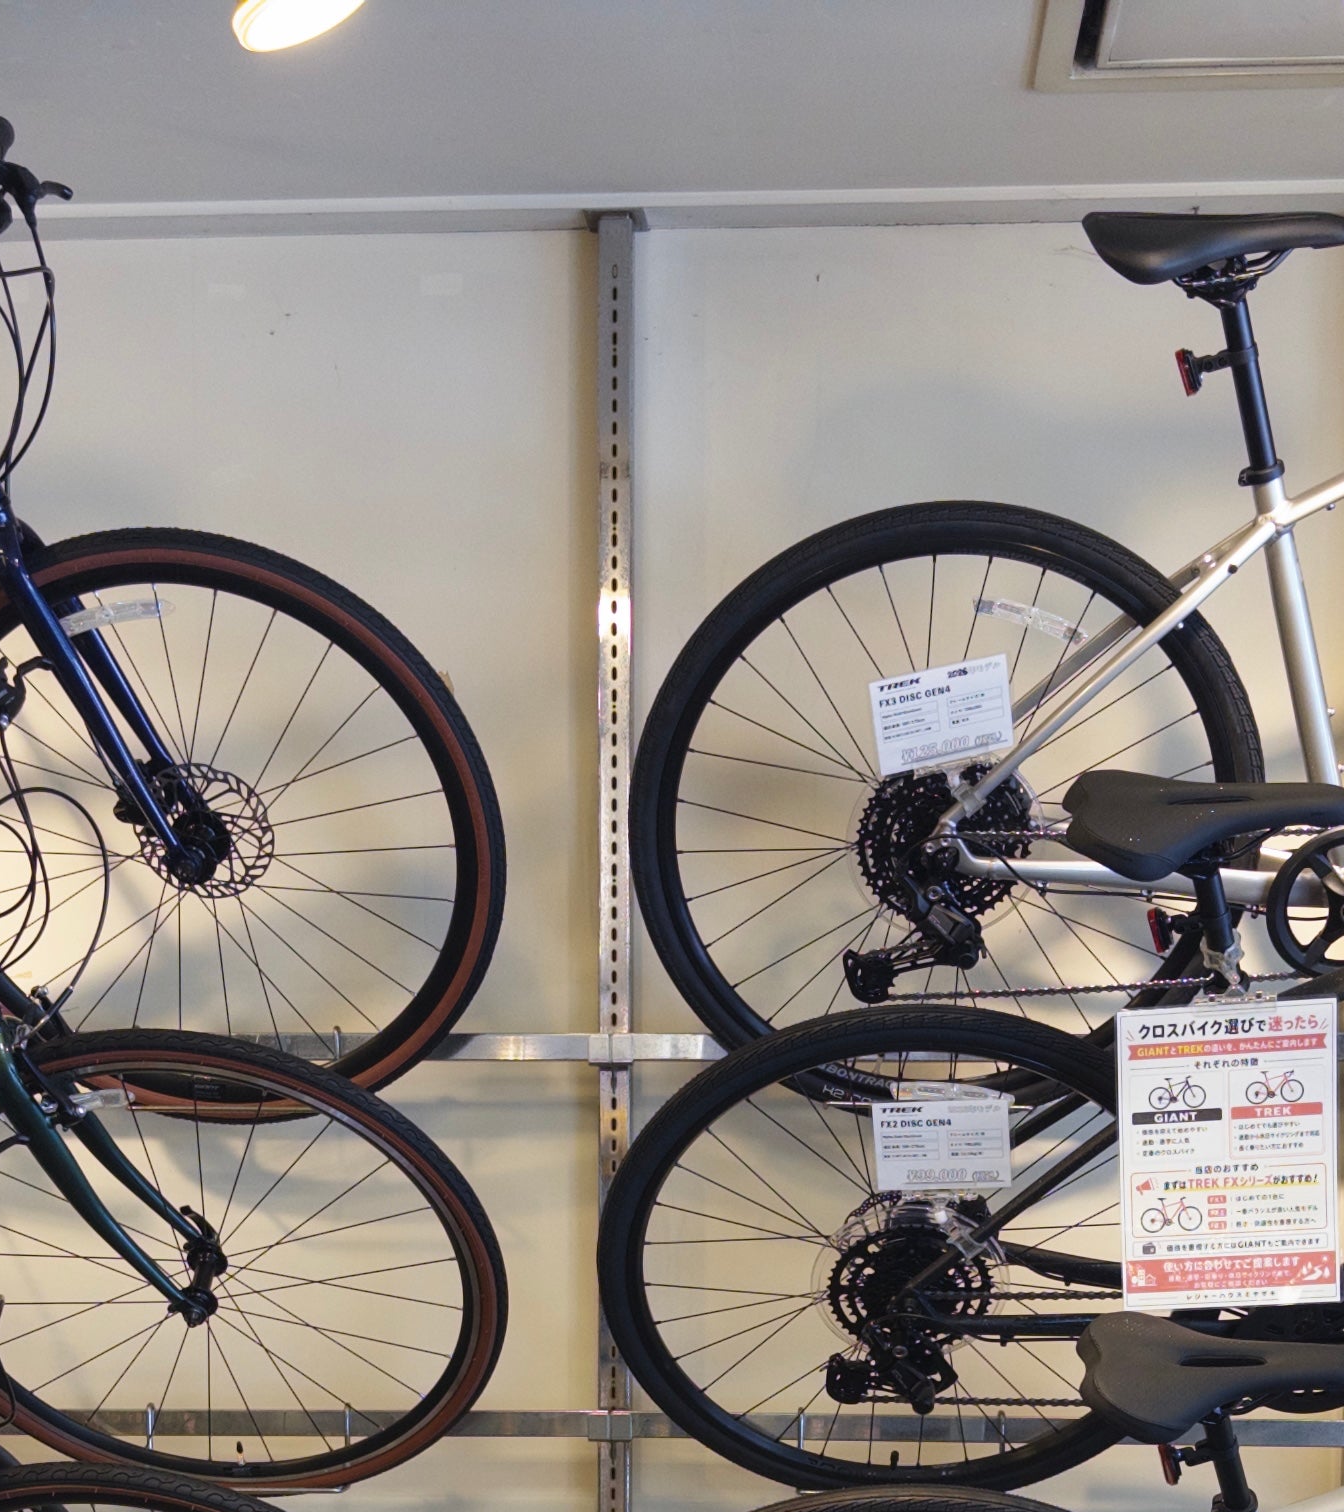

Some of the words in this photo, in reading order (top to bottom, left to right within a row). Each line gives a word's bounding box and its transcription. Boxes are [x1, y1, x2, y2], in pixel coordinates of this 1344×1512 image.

[878, 677, 921, 692] TREK
[879, 695, 898, 708] FX3
[899, 692, 922, 704] DISC
[925, 685, 951, 698] GEN4
[1137, 1014, 1320, 1041] クロスバイク選びで迷ったら
[880, 1106, 923, 1115] TREK
[1255, 1106, 1293, 1117] TREK
[1154, 1111, 1198, 1123] GIANT
[881, 1120, 897, 1129] FX2
[901, 1119, 923, 1127] DISC
[926, 1118, 952, 1127] GEN4
